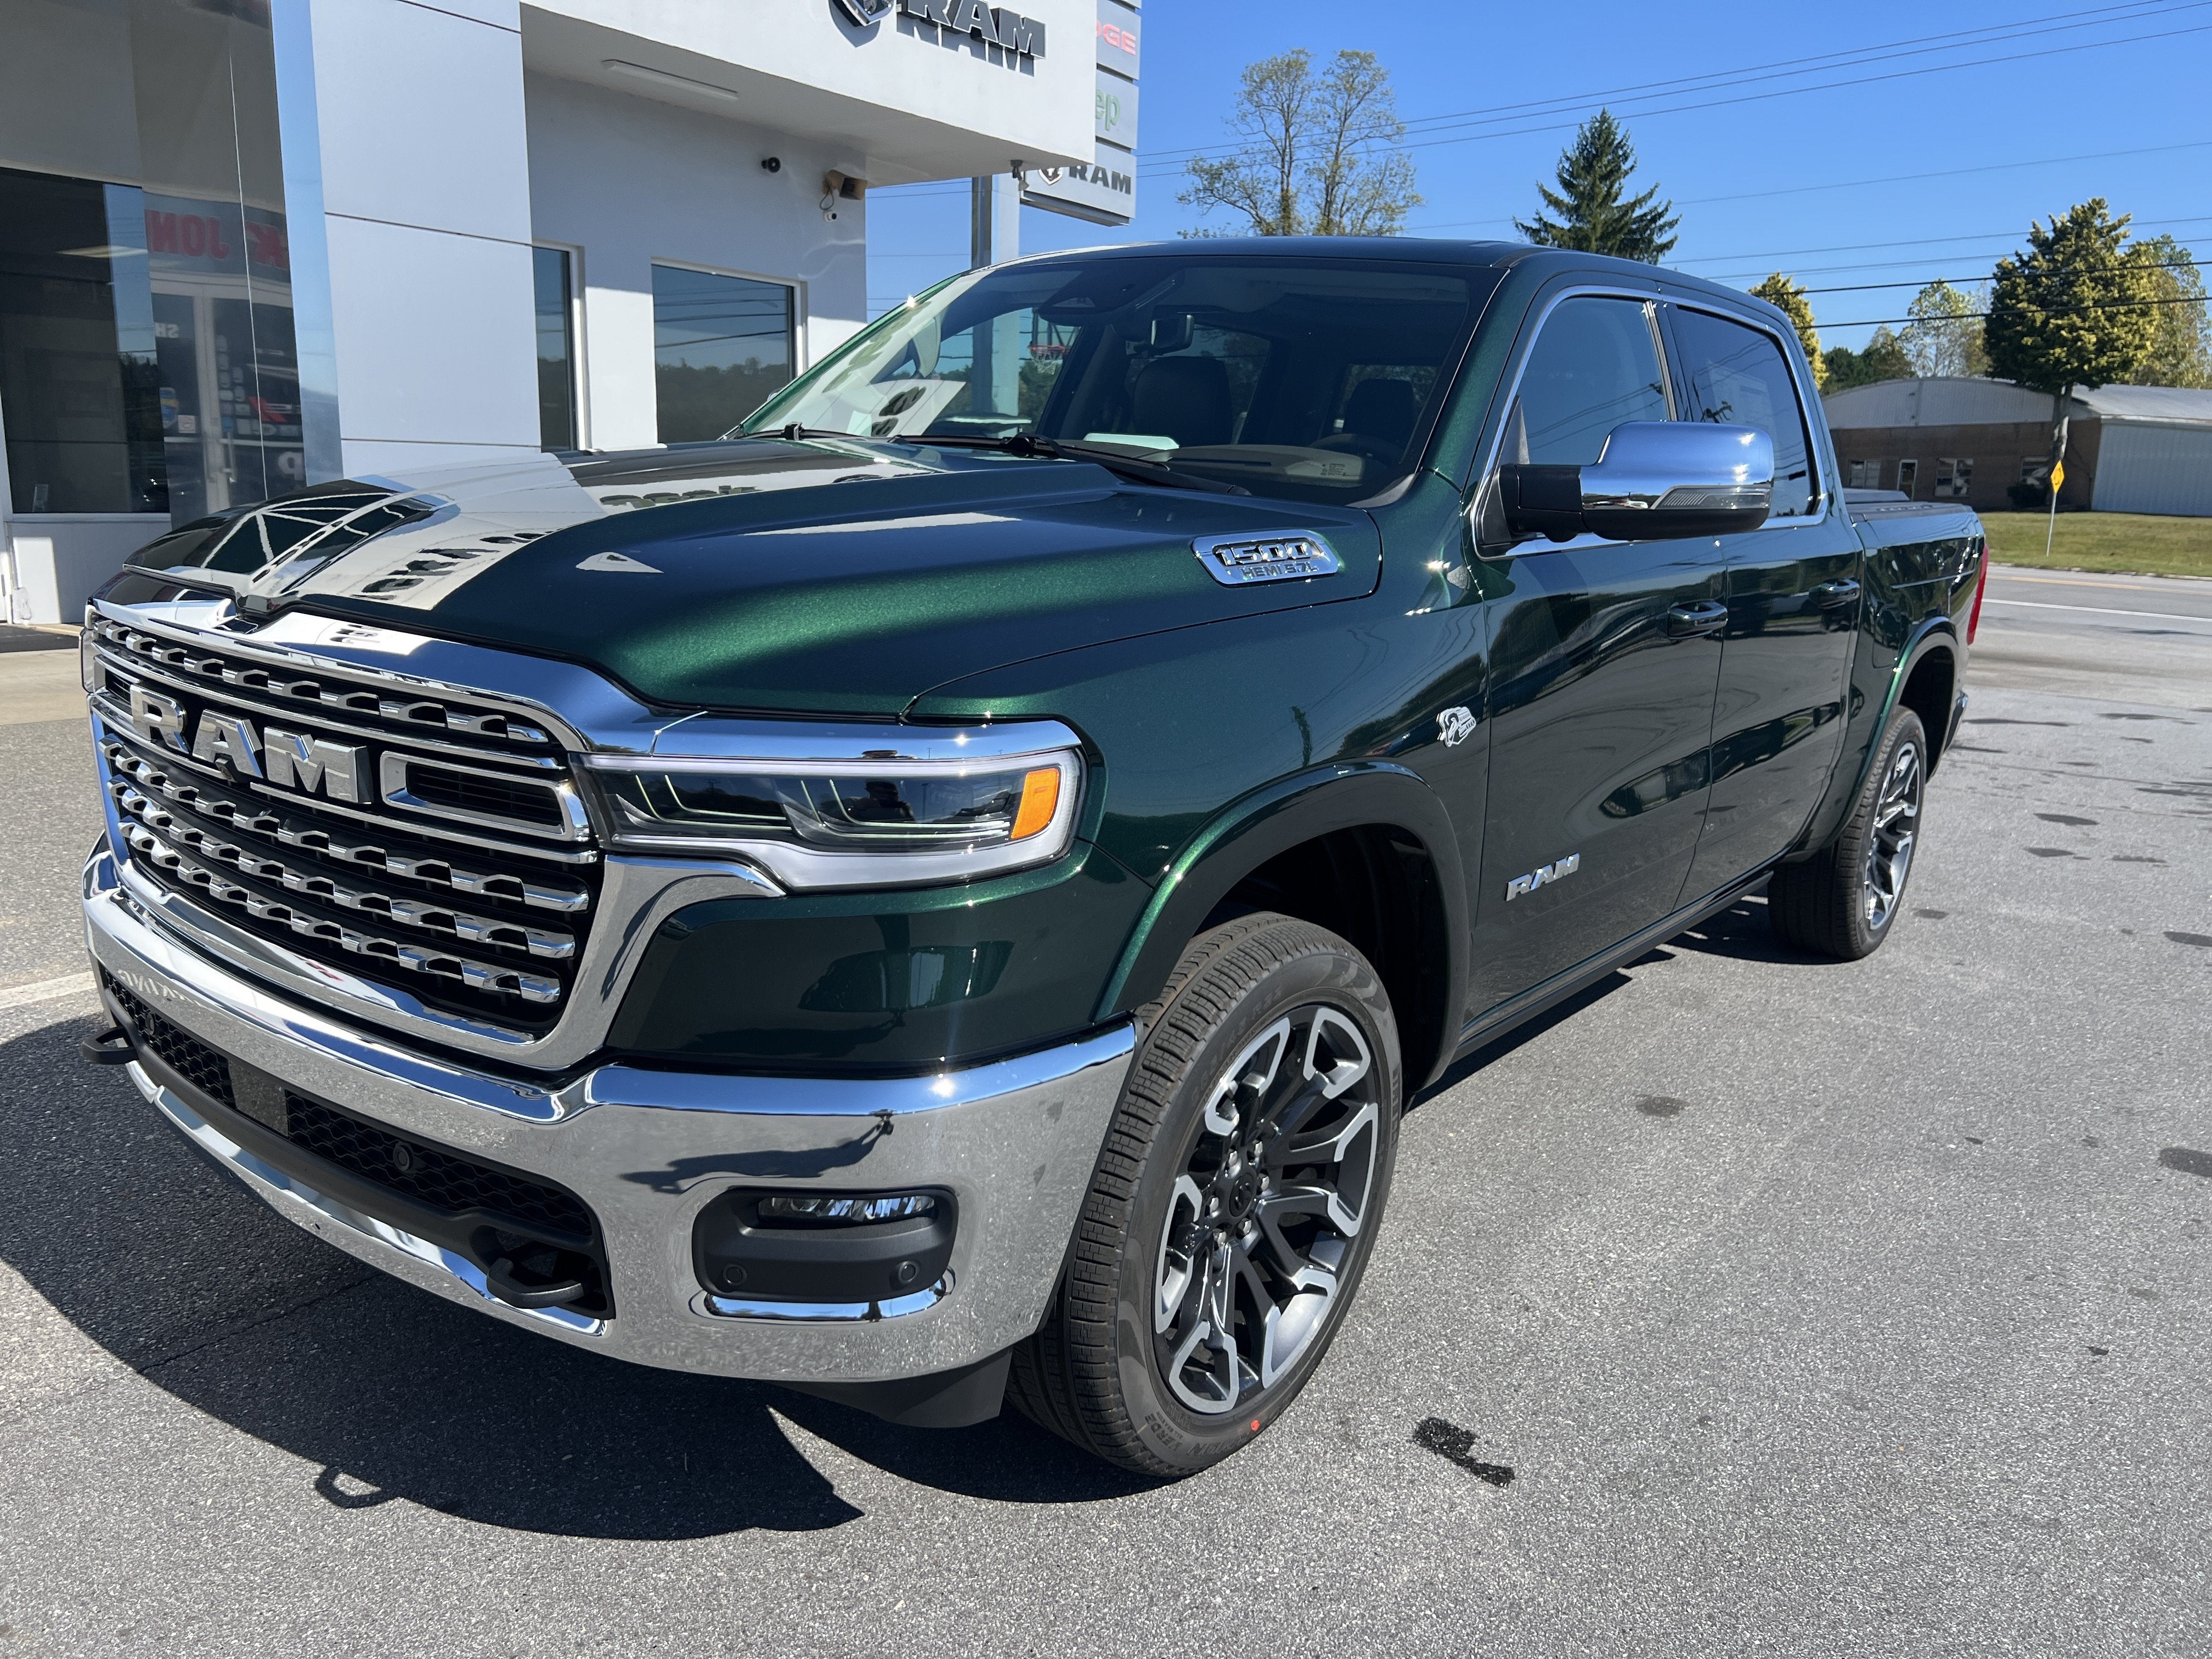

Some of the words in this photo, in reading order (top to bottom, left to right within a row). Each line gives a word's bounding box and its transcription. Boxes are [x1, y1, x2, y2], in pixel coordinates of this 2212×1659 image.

[1069, 165, 1131, 195] RAM
[1215, 541, 1313, 566] 1500
[1241, 564, 1283, 578] HEMI
[1284, 562, 1318, 574] 5.7L
[130, 684, 374, 804] RAM
[1504, 853, 1579, 901] RAM
[1144, 1413, 1183, 1452] VERDE
